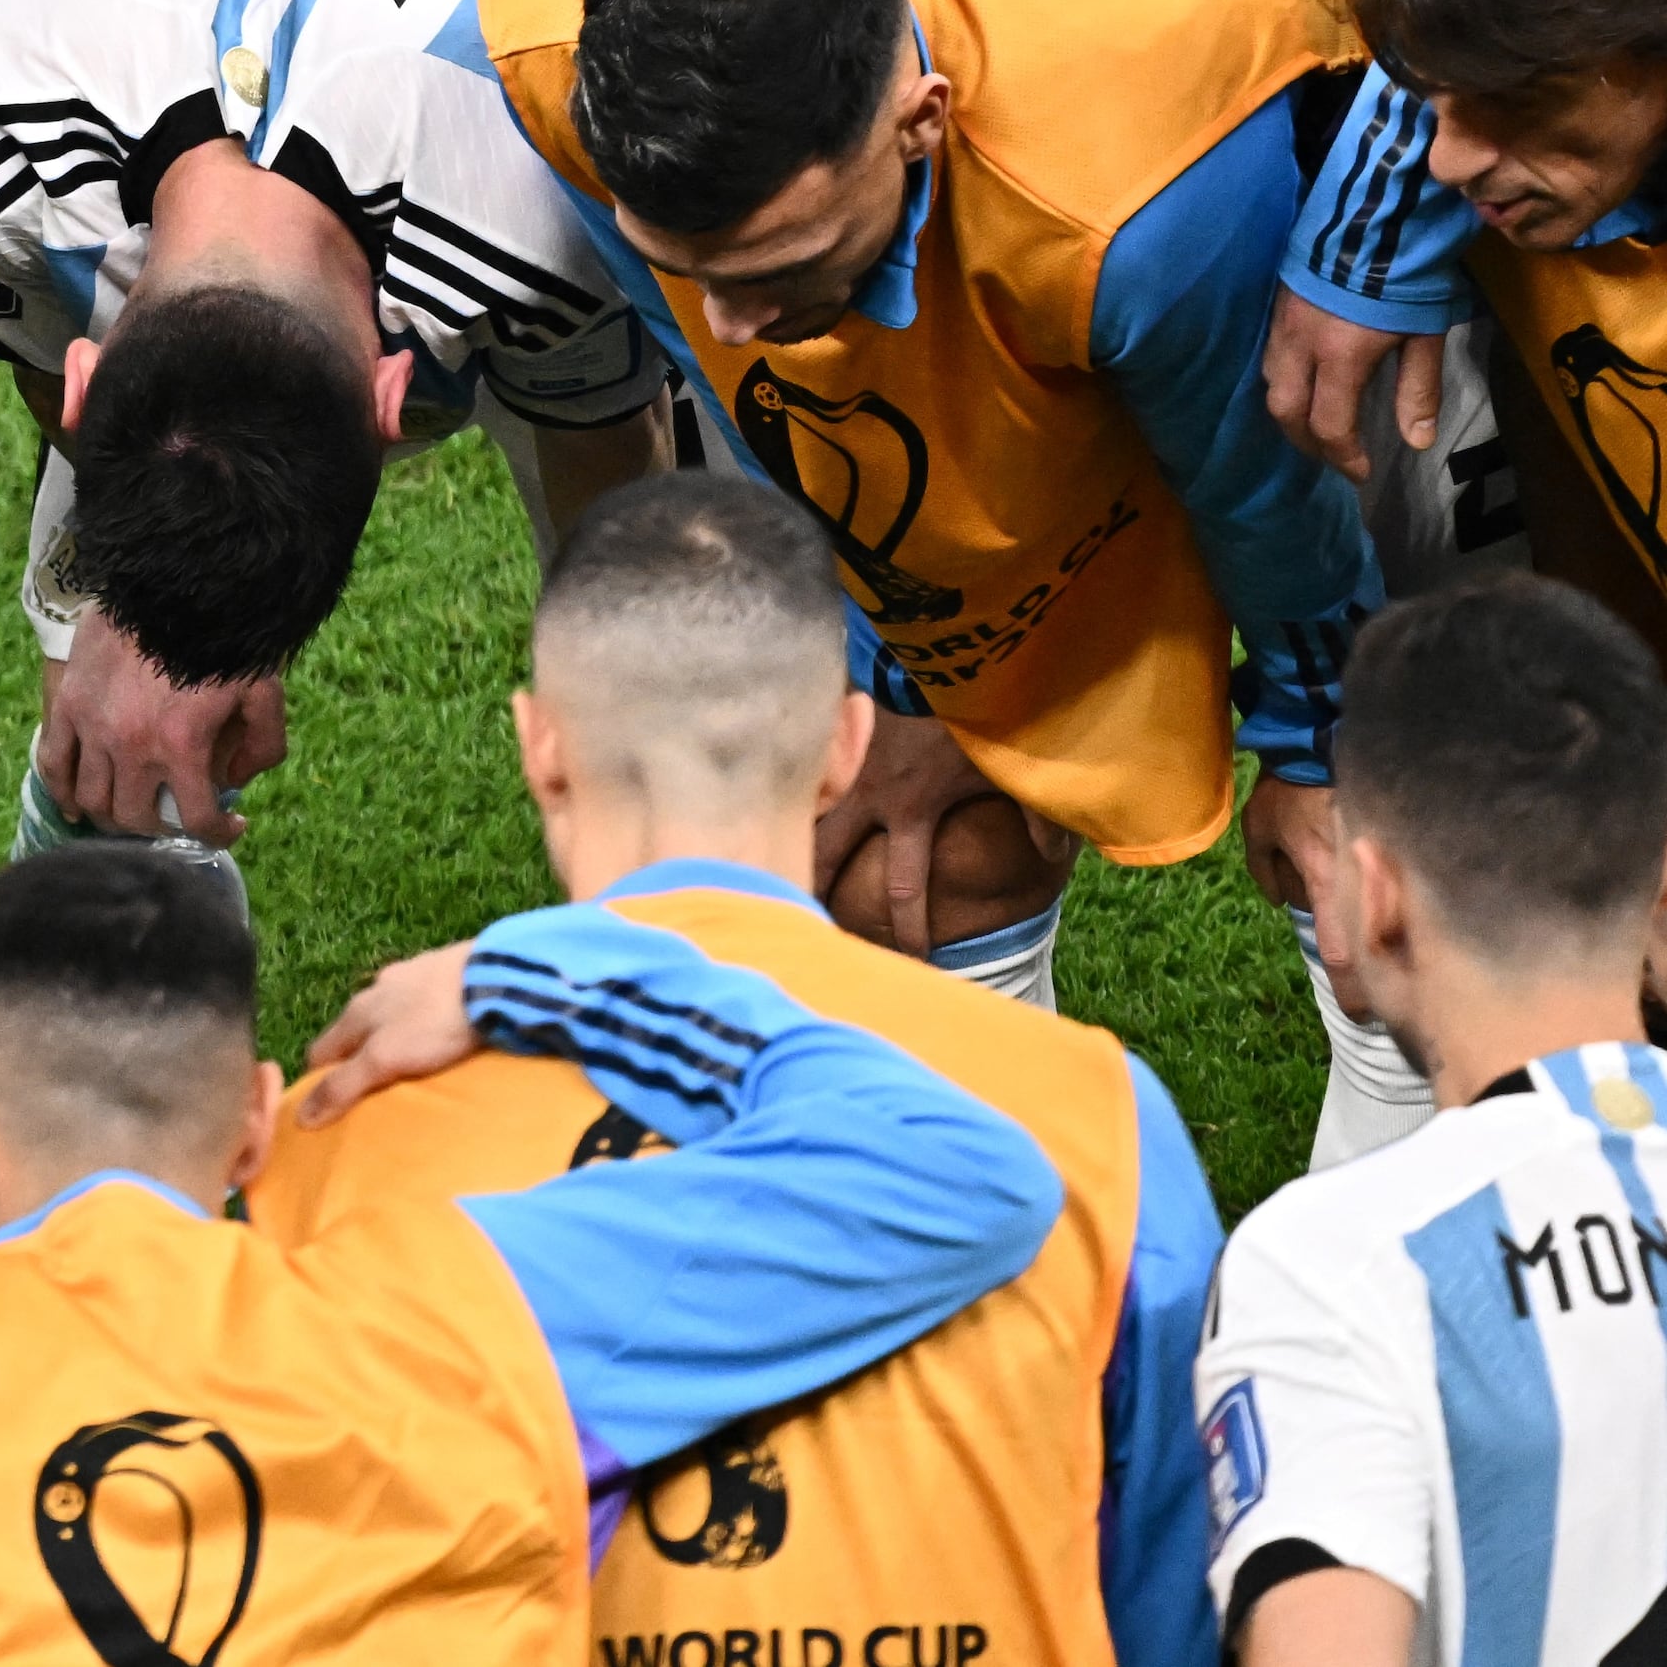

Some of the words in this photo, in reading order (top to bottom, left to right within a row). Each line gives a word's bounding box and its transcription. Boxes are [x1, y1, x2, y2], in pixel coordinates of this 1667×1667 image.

[883, 583, 1052, 662] ORLD
[603, 1628, 843, 1667] WORLD
[864, 1624, 989, 1667] CUP
